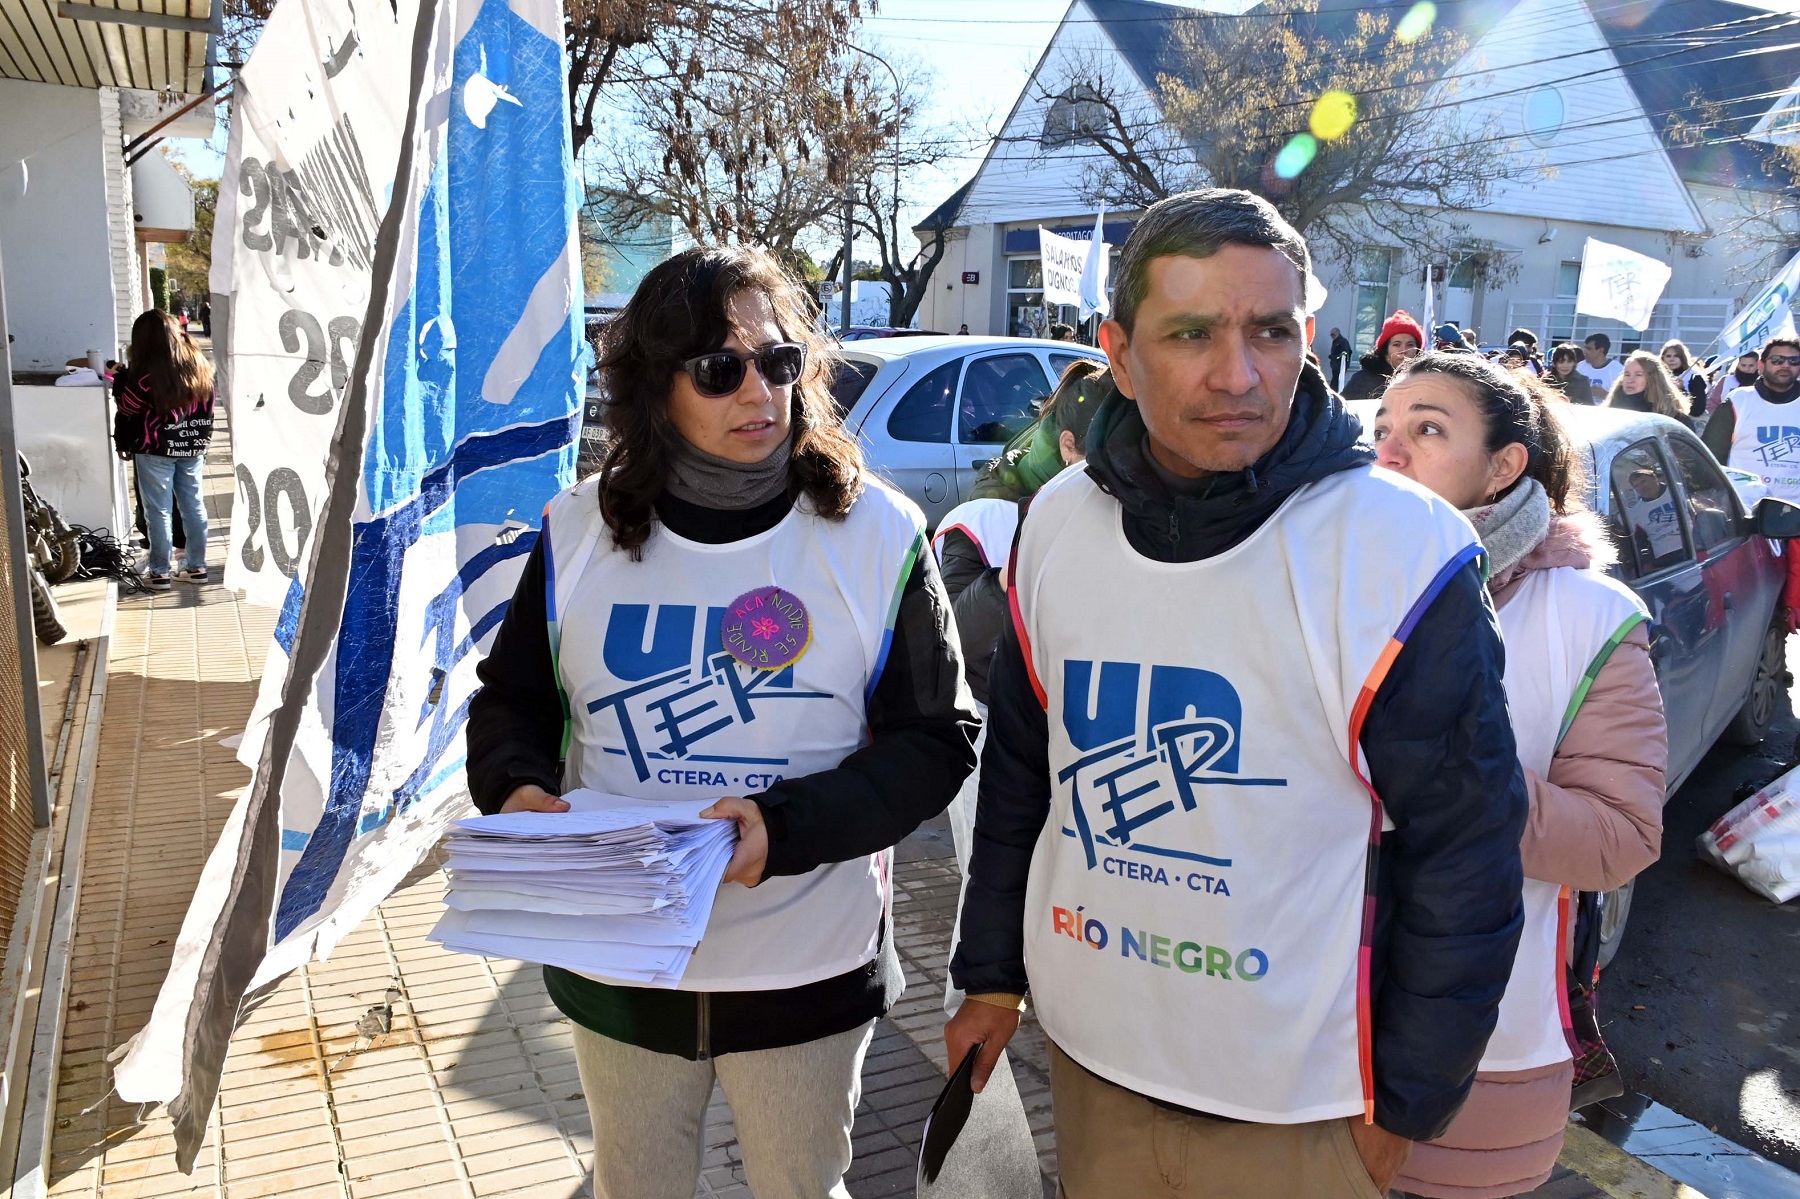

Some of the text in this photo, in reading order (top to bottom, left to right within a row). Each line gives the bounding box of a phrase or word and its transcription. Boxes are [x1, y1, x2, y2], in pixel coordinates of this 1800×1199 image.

[179, 429, 199, 438] Club
[167, 438, 210, 448] June 202
[167, 448, 192, 457] Limited
[657, 769, 728, 787] CTERA
[1103, 857, 1231, 897] CTERA CTA
[1052, 905, 1269, 982] RÍO NEGRO
